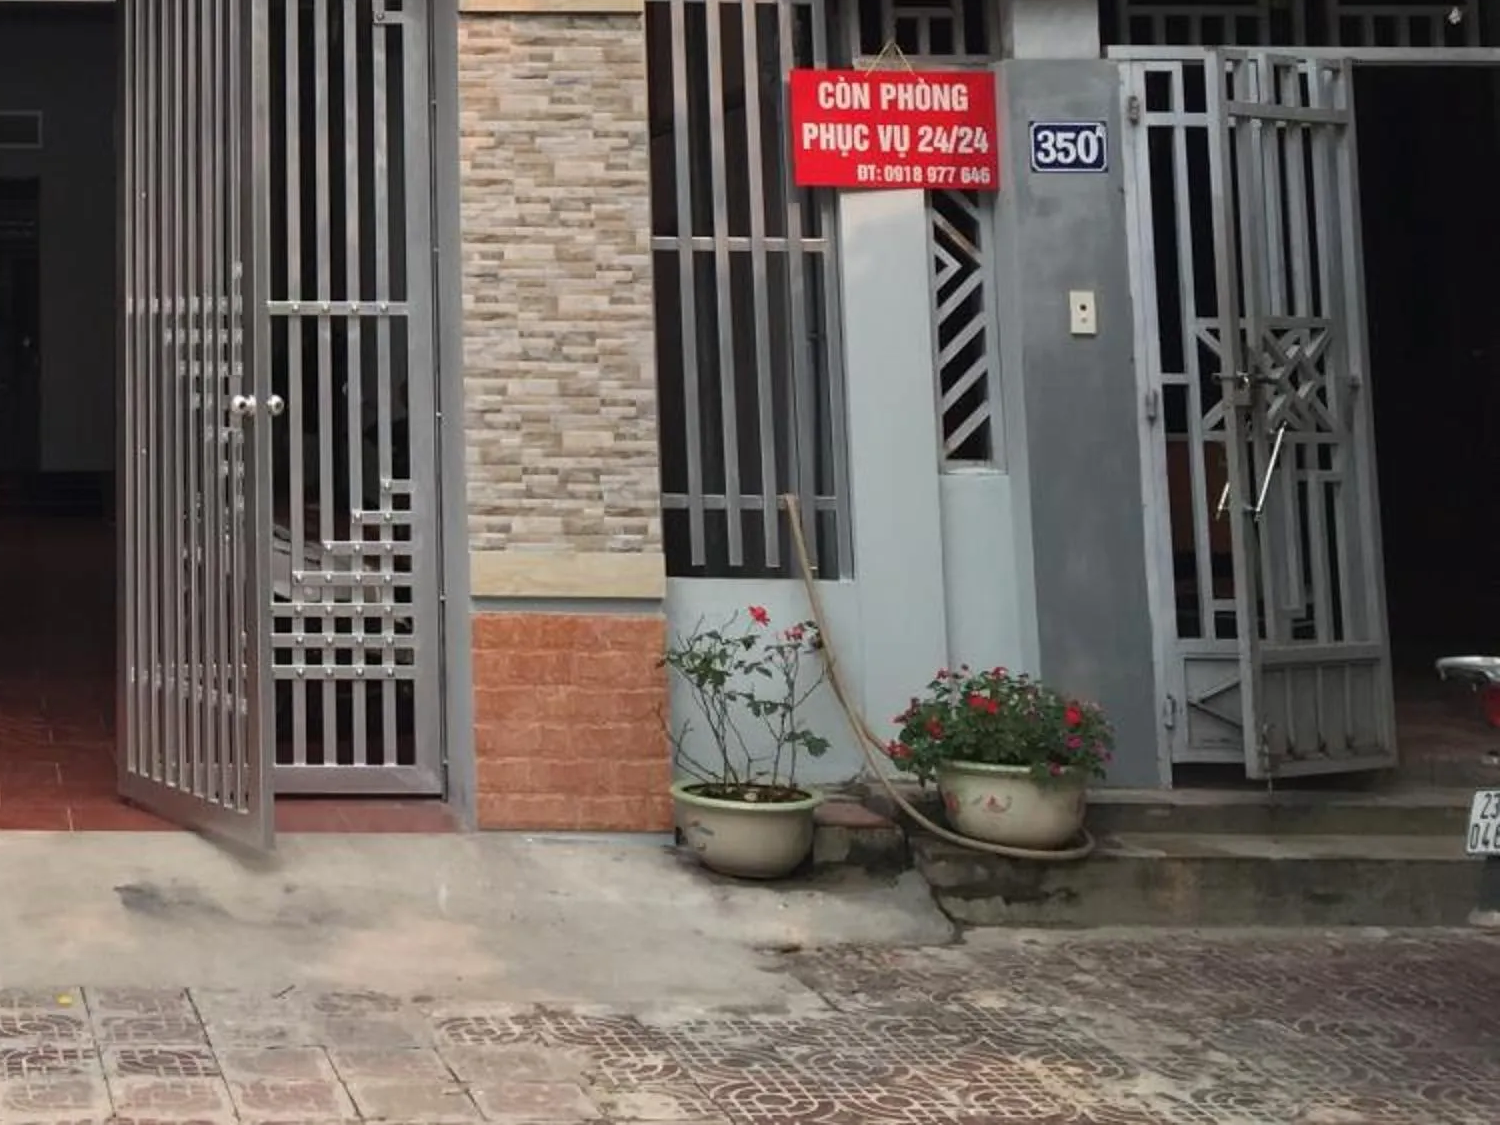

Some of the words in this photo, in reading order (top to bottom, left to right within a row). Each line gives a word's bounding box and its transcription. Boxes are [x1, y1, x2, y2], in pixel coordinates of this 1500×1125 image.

[879, 77, 969, 112] PHÒNG
[801, 122, 870, 157] PHỤC
[877, 123, 911, 158] VỤ
[917, 124, 989, 155] 24/24
[883, 164, 923, 183] 0918
[927, 165, 957, 184] 977
